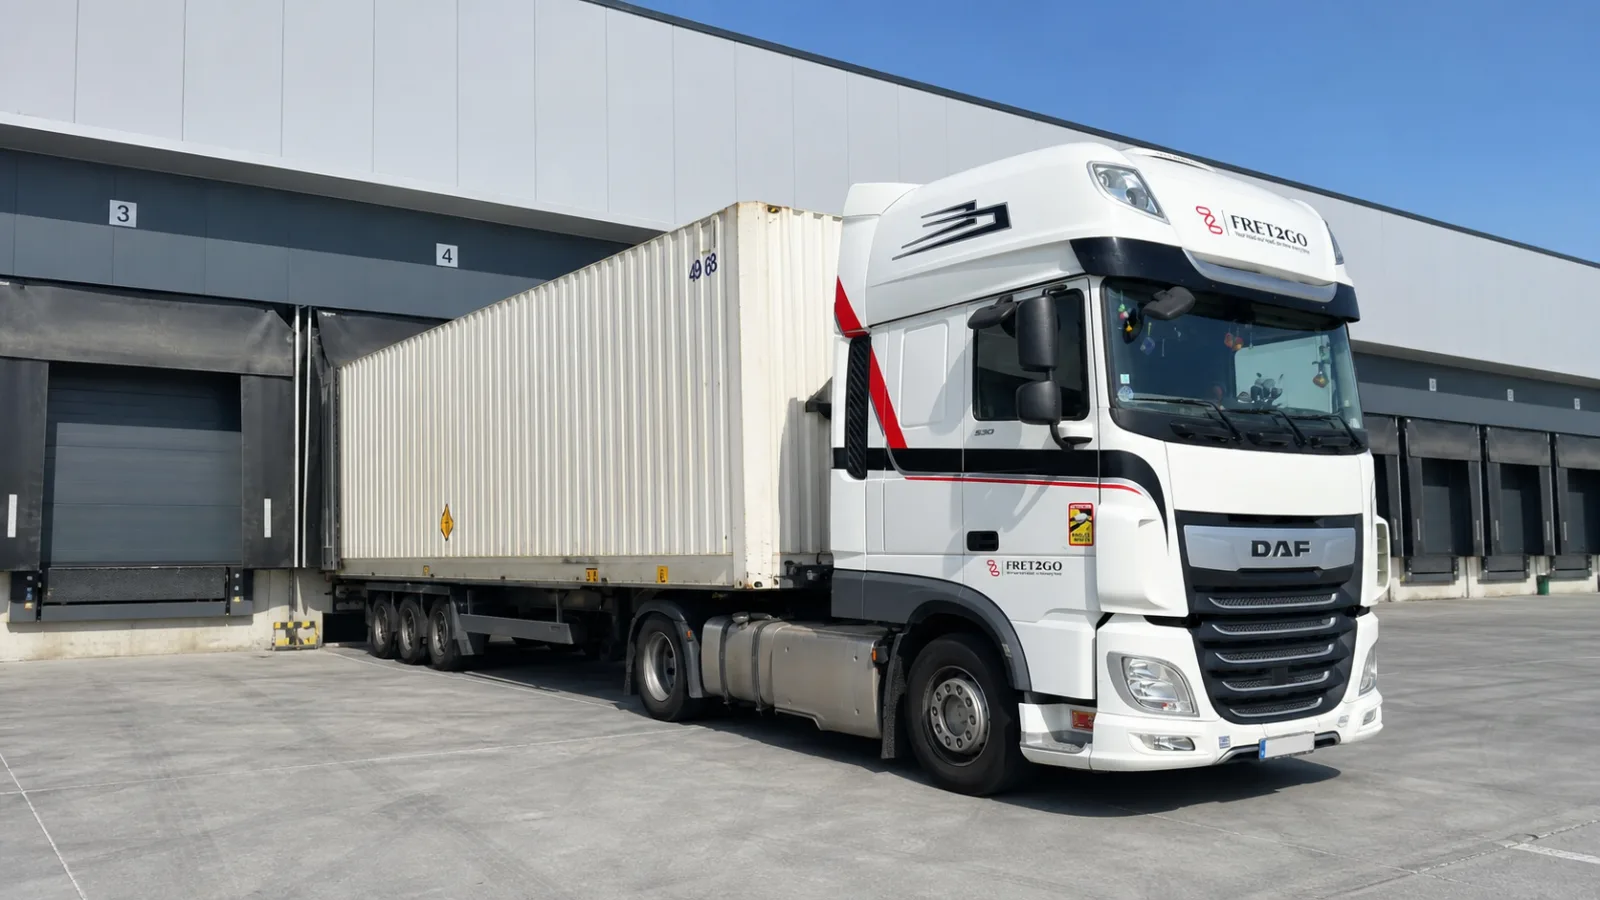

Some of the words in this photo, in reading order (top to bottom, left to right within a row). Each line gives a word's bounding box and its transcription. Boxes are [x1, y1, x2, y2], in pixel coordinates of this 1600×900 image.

[117, 205, 130, 222] 3
[1230, 215, 1308, 247] FRET2GO
[441, 248, 453, 264] 4
[1251, 540, 1311, 558] DAF
[1006, 560, 1063, 571] FRET2GO
